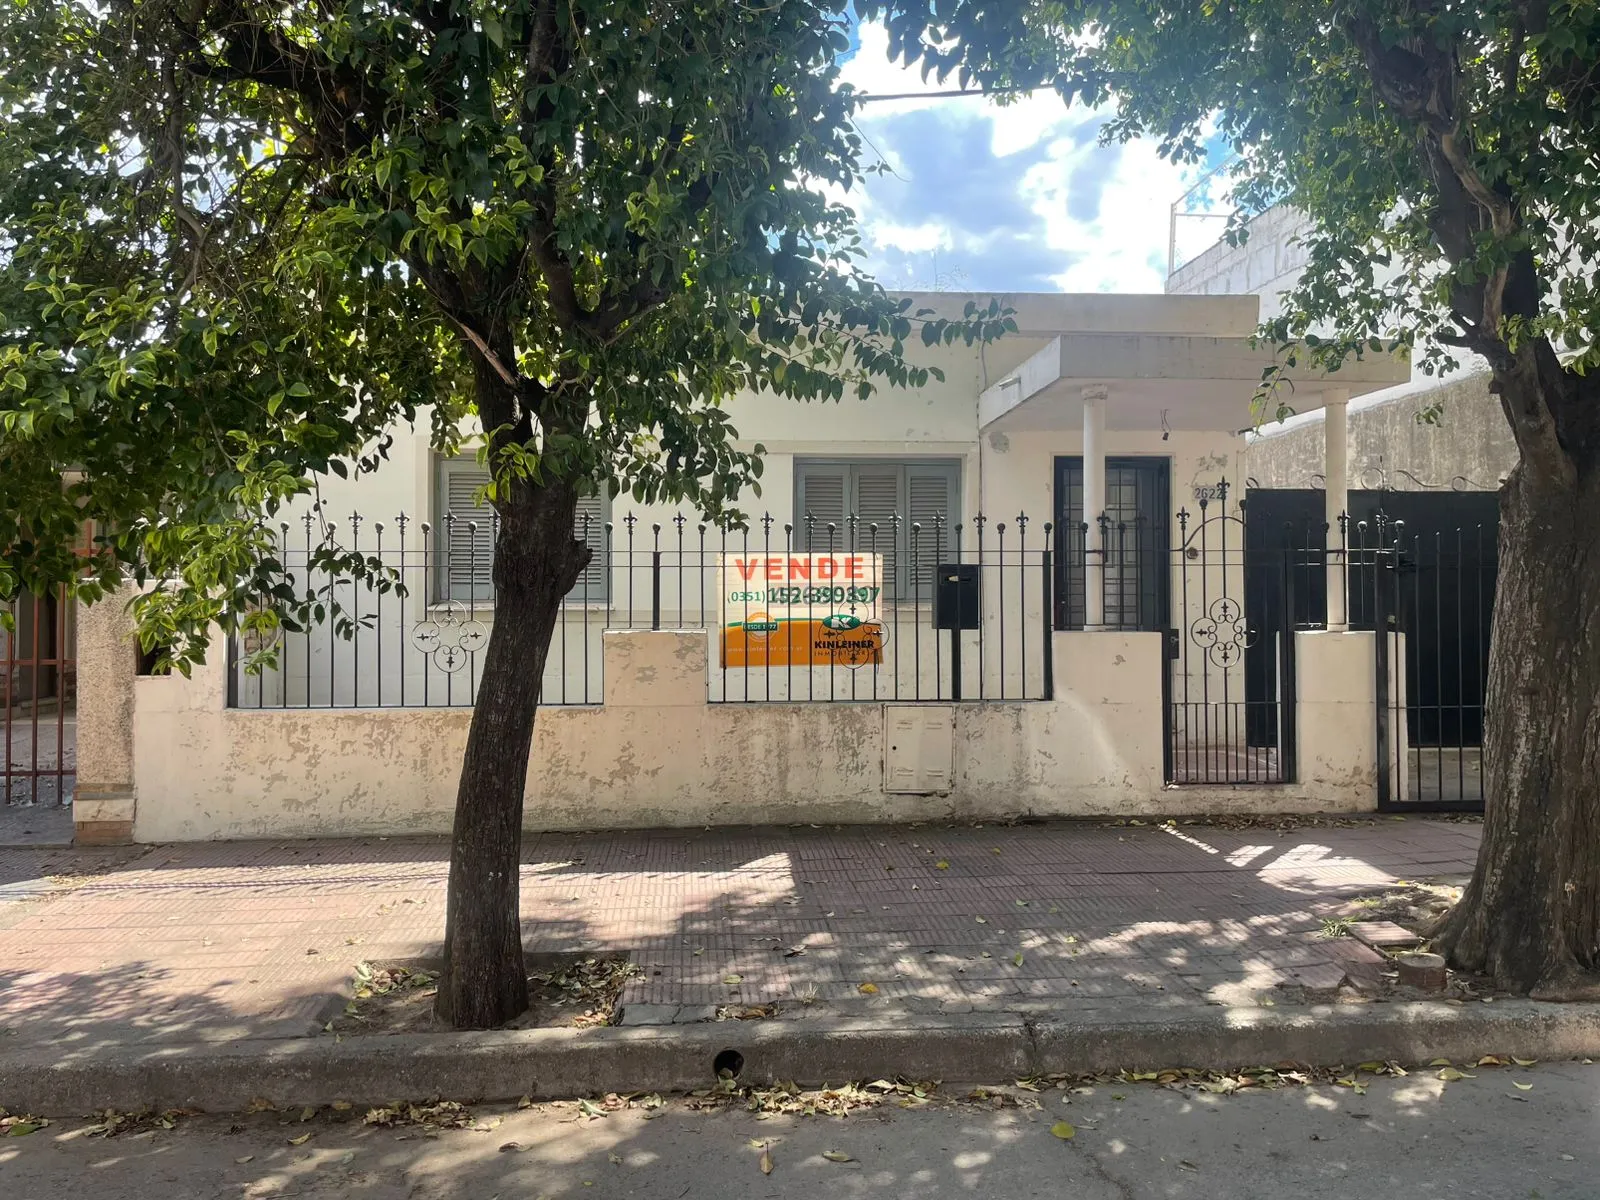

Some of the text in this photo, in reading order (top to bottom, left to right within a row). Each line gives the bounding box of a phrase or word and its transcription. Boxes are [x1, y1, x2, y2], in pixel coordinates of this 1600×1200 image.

[735, 558, 864, 580] VENDE
[727, 591, 765, 604] (0351)
[815, 640, 875, 649] KINLEINER
